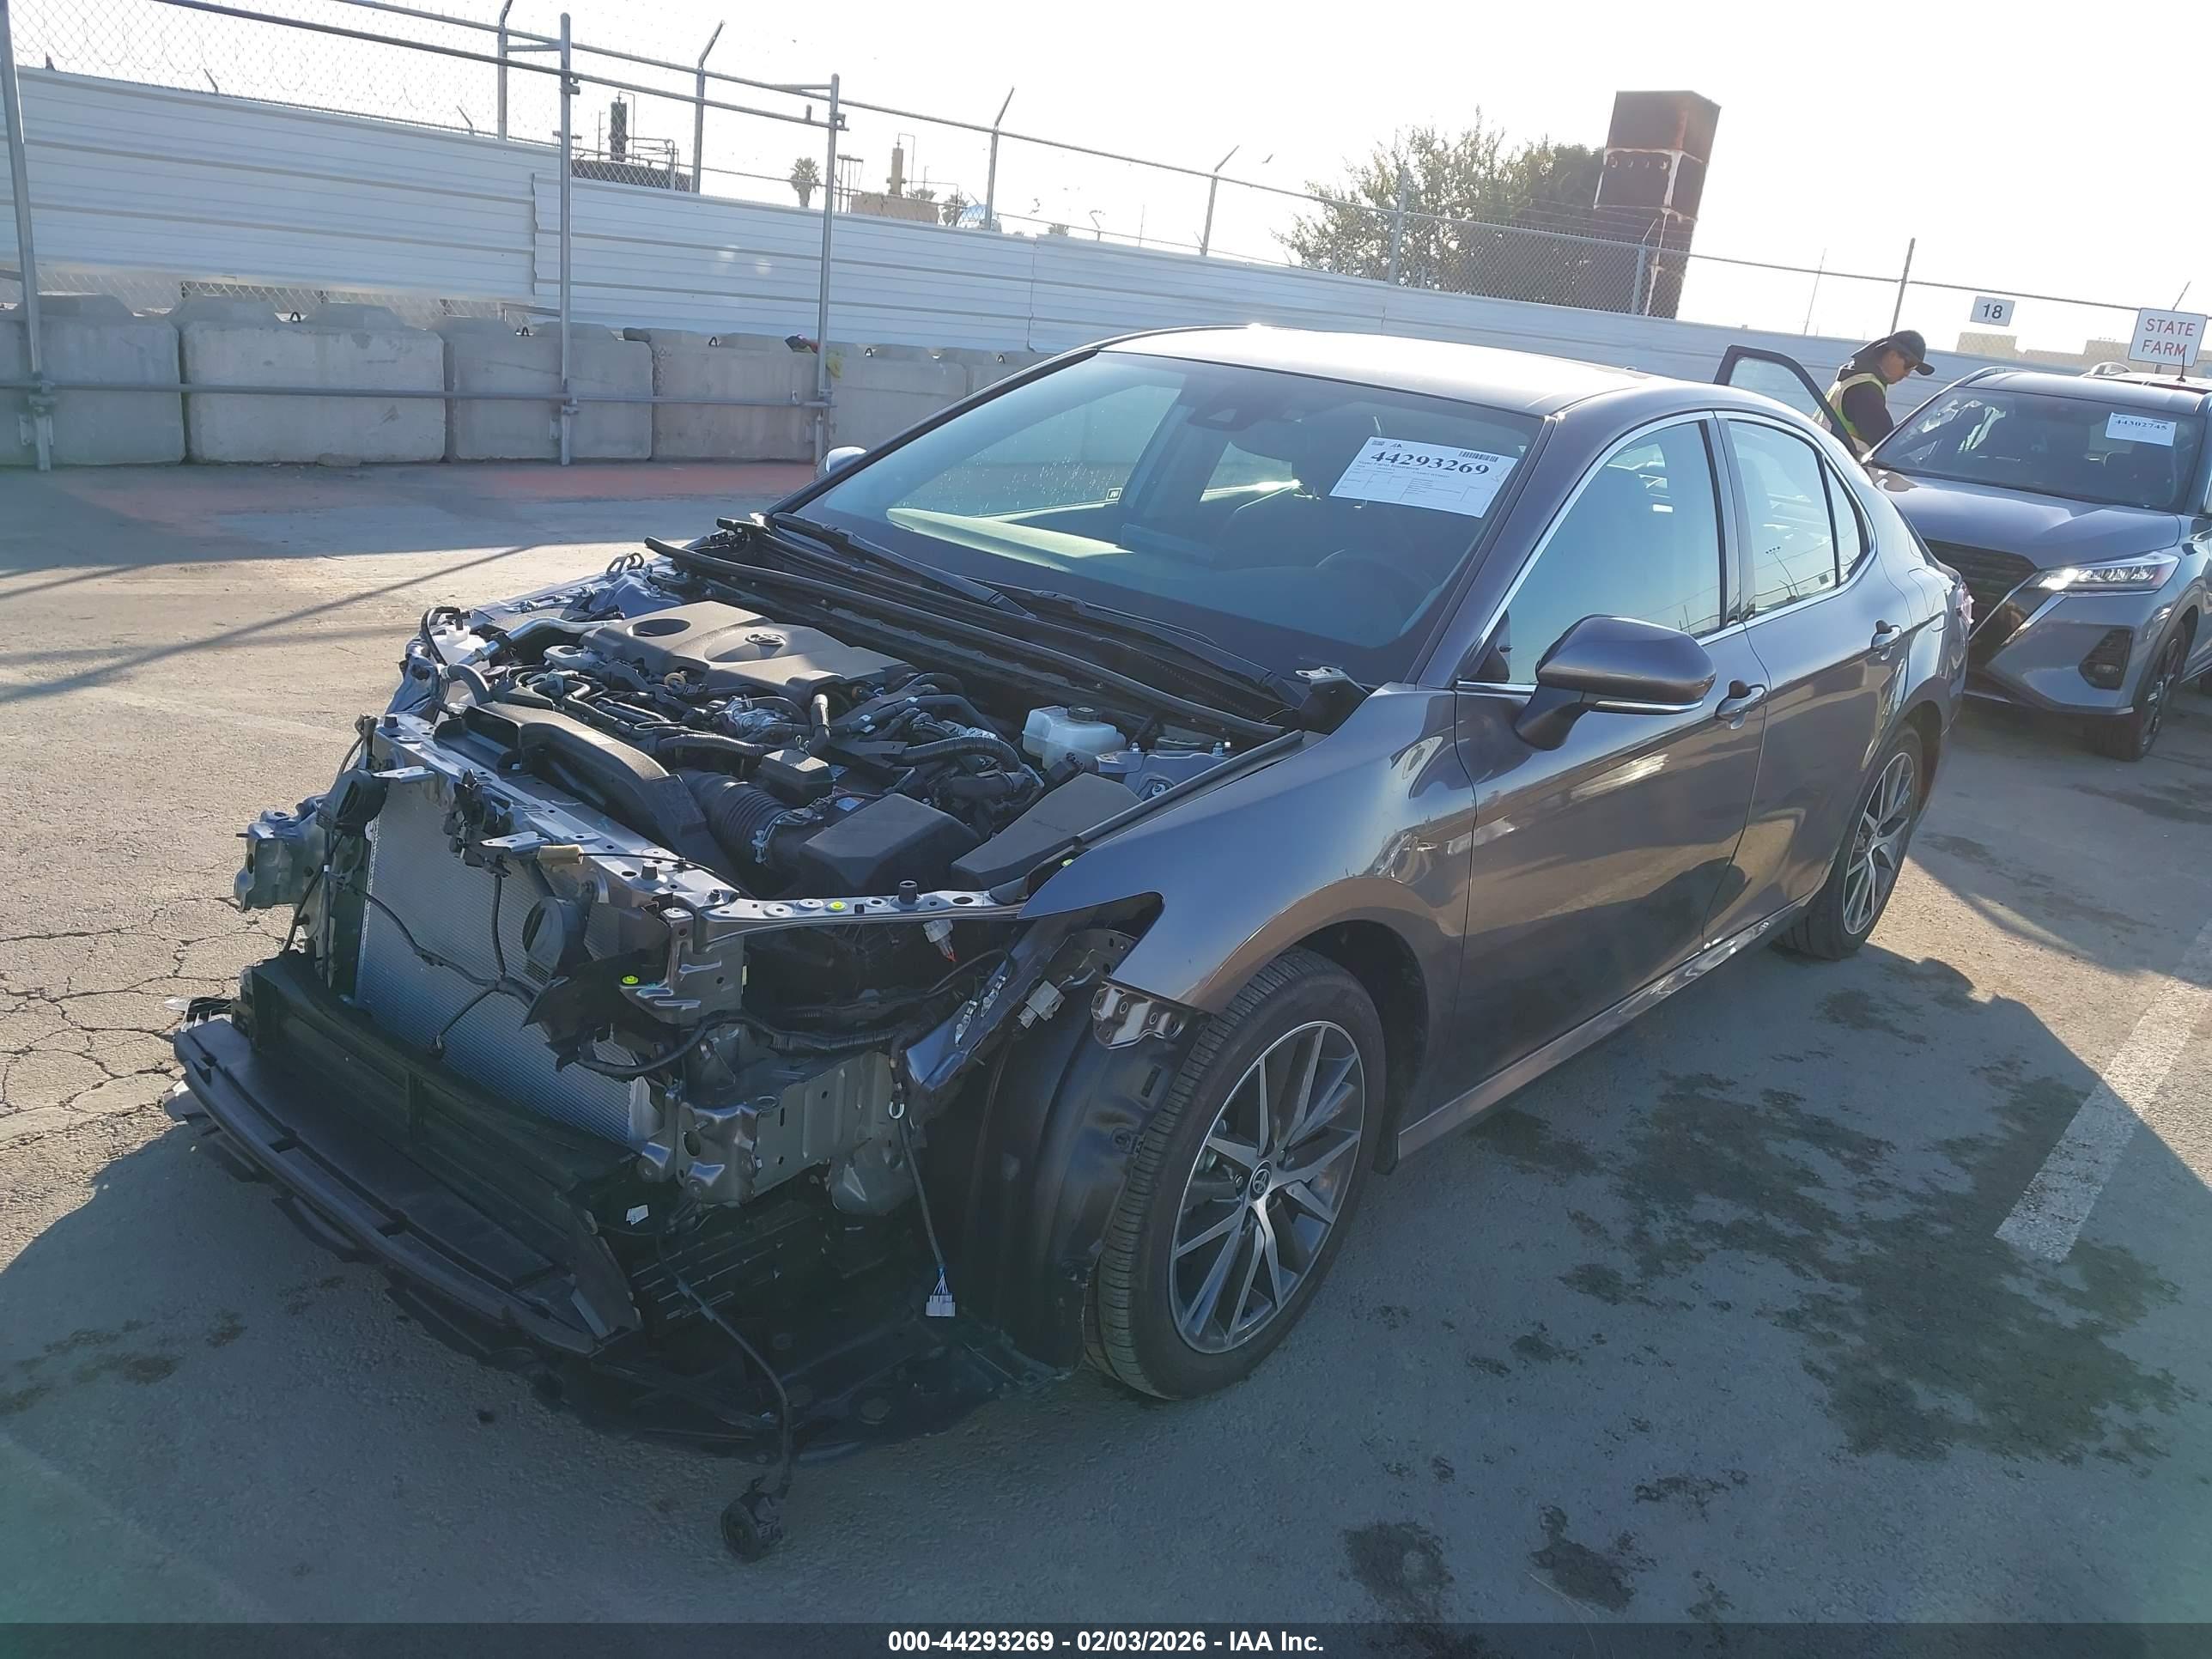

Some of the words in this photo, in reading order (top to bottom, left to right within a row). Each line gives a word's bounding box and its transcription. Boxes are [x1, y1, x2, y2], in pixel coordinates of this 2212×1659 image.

[1983, 304, 2003, 319] 18
[2145, 318, 2196, 337] STATE
[2142, 339, 2187, 356] FARM
[1370, 451, 1490, 475] 44293269
